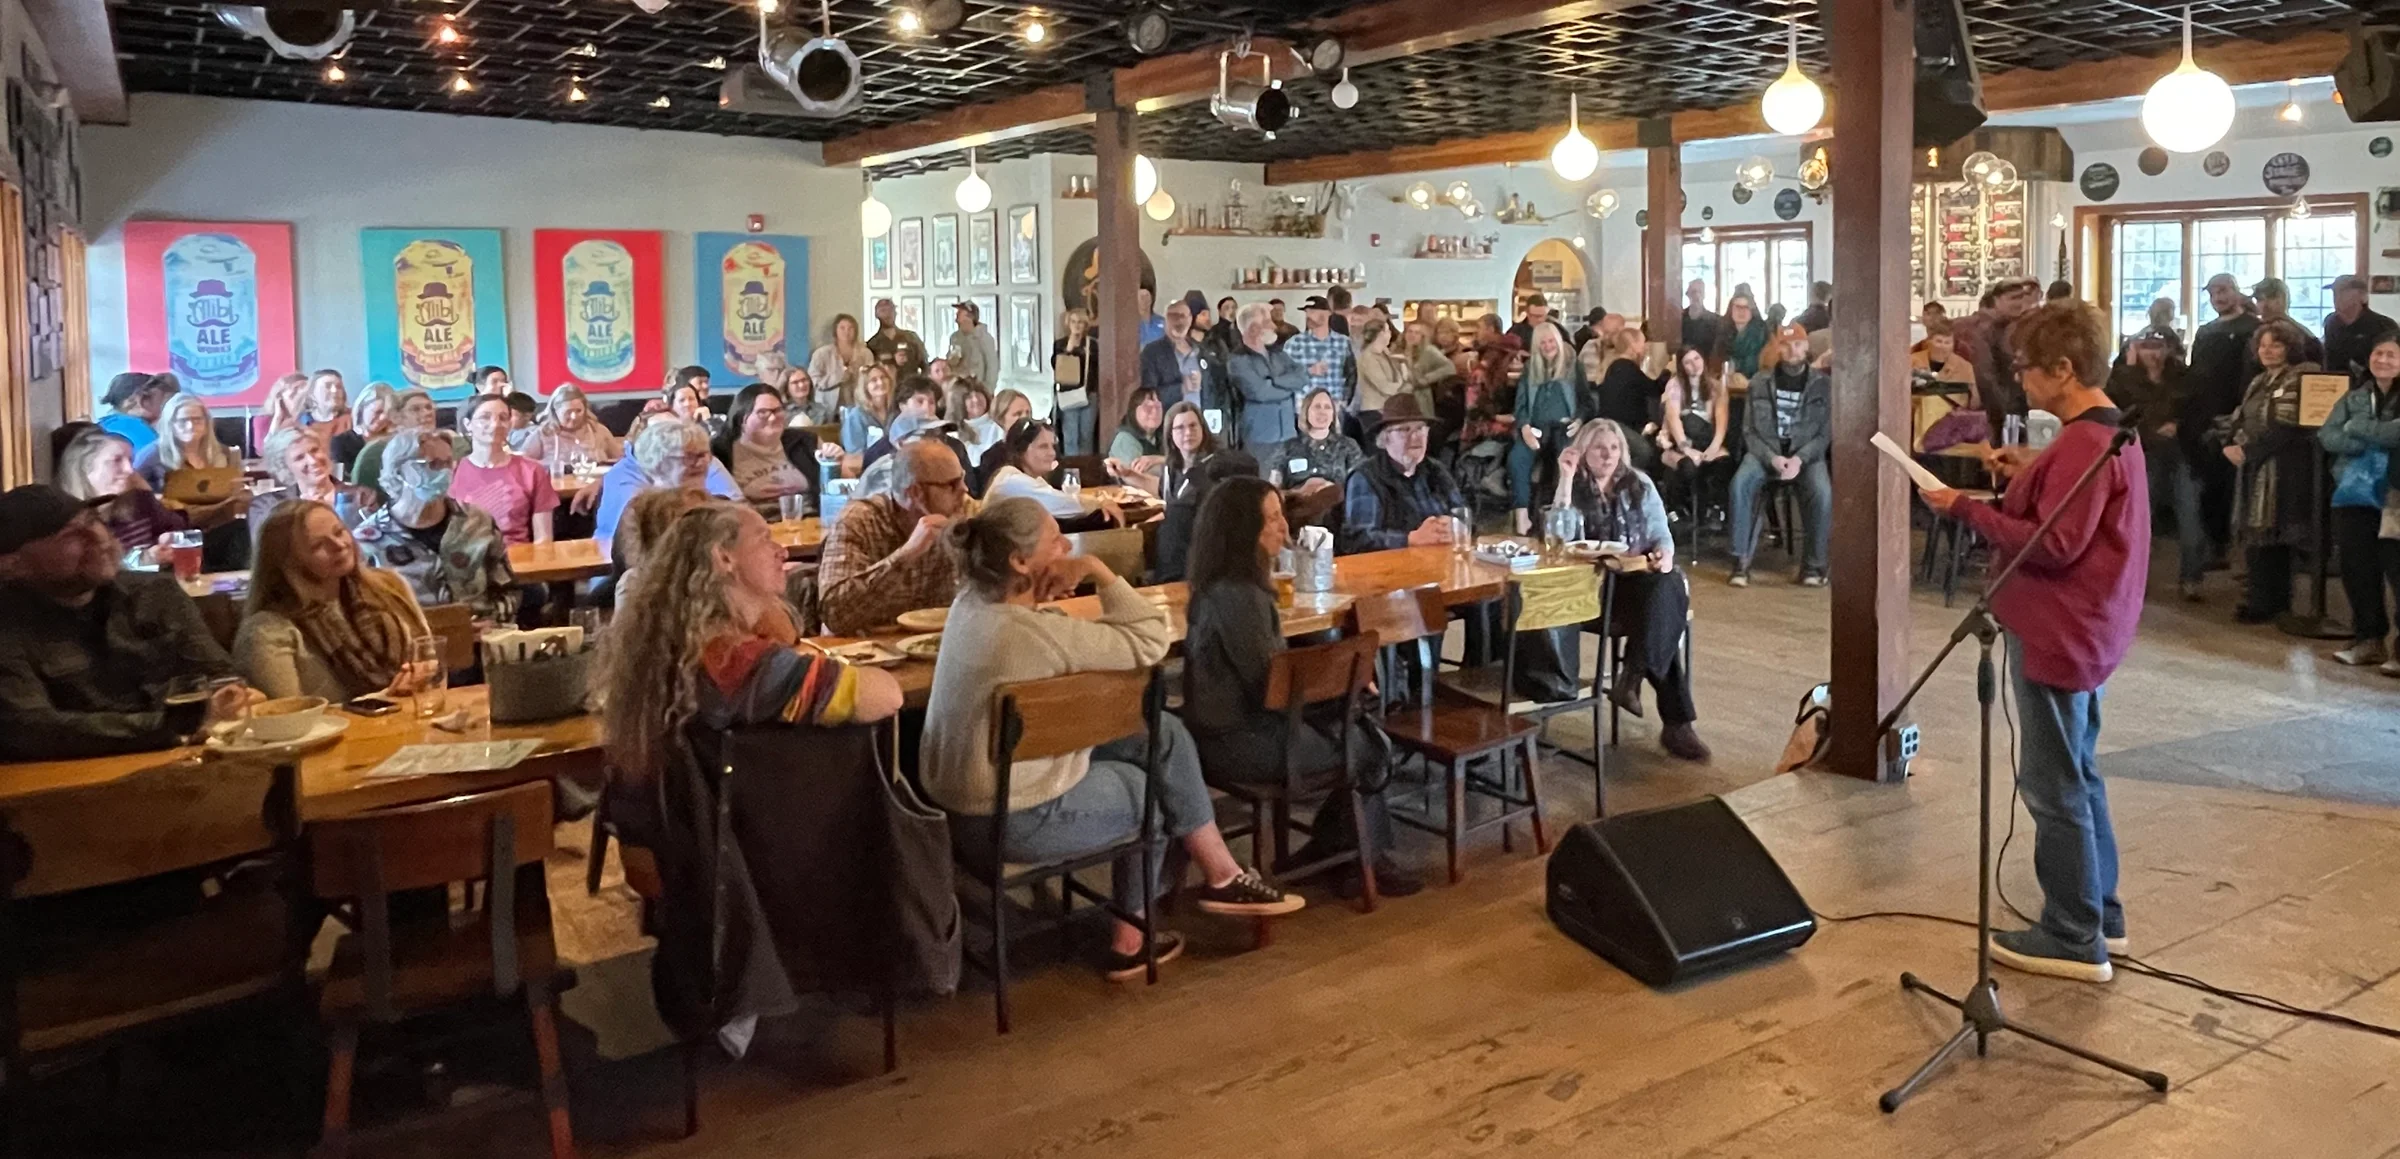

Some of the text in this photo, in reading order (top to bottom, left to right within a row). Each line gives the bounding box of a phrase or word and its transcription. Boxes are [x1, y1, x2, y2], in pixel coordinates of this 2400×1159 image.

[424, 327, 453, 342] ALE
[587, 323, 612, 338] ALE
[743, 321, 766, 334] ALE
[197, 328, 232, 345] ALE
[424, 342, 453, 351] WORKS
